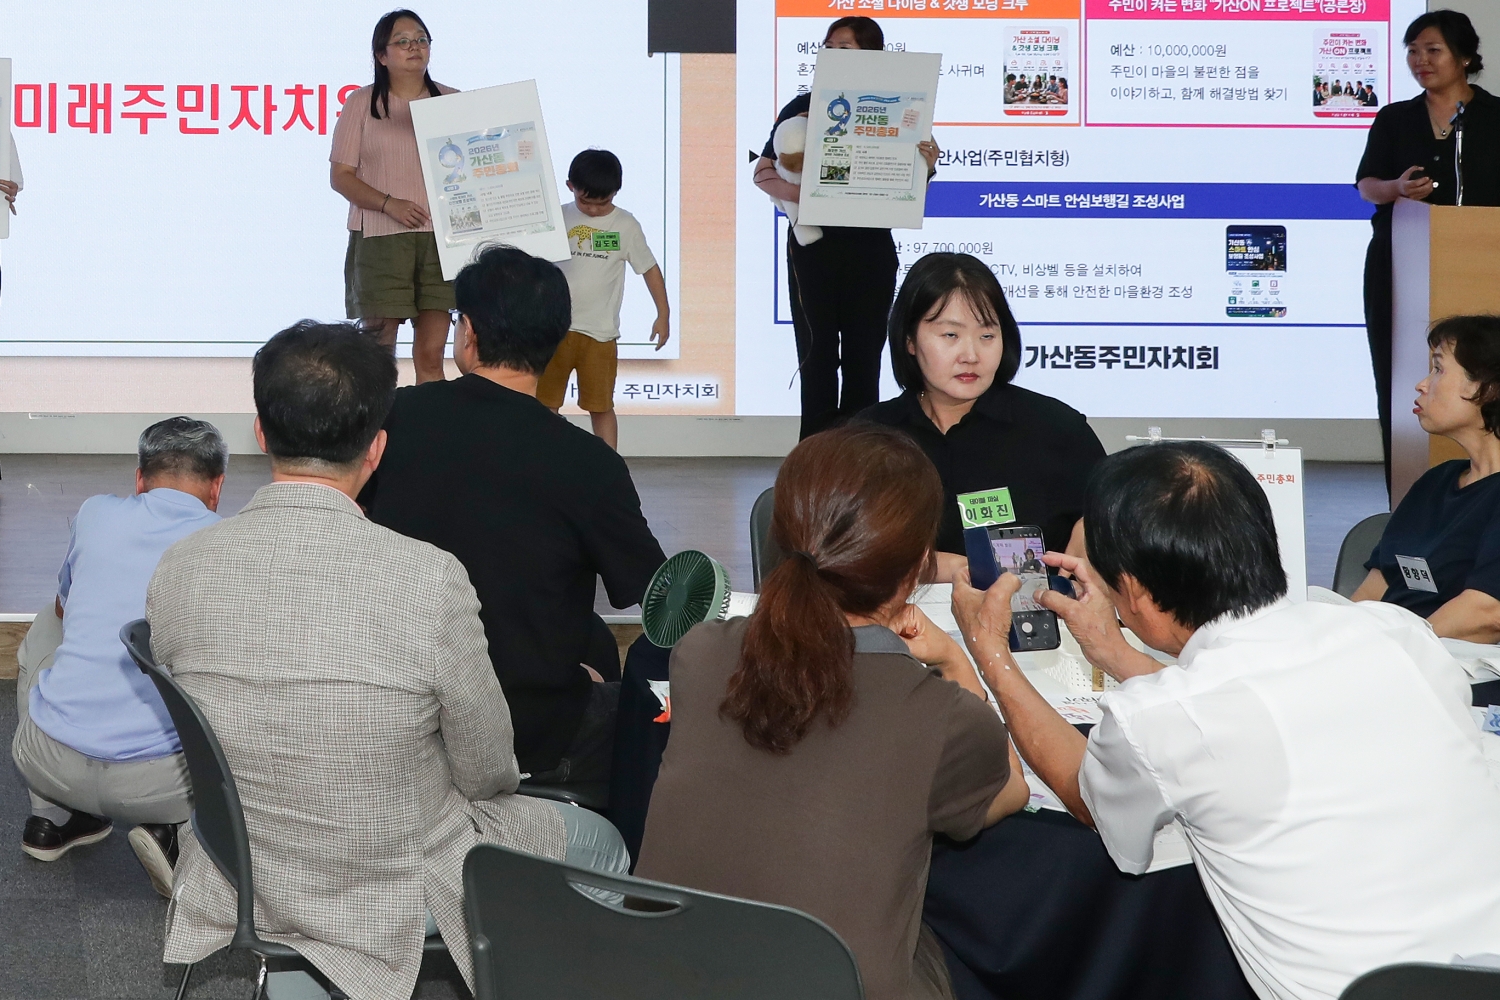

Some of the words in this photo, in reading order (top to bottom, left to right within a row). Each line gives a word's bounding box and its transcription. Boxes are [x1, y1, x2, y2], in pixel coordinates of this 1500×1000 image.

[1110, 44, 1135, 57] 예산
[1148, 44, 1227, 58] 10,000,000원
[1110, 65, 1147, 79] 주민이
[1152, 65, 1189, 79] 마을의
[1193, 65, 1231, 79] 불편한
[1234, 65, 1260, 79] 점을
[1110, 87, 1176, 101] 이야기하고,
[1181, 87, 1205, 101] 함께
[1209, 87, 1259, 101] 해결방법
[1264, 87, 1288, 101] 찾기
[14, 82, 362, 136] 미래주민자치
[855, 114, 889, 126] 가산동
[854, 126, 899, 137] 주민총회
[979, 193, 1019, 209] 가산동
[1022, 193, 1062, 209] 스마트
[1064, 193, 1129, 209] 안심보행길
[1132, 193, 1185, 209] 조성사업
[1022, 263, 1059, 278] 비상벨
[1064, 263, 1088, 278] 등을
[1092, 263, 1142, 278] 설치하여
[1044, 284, 1068, 299] 통해
[1072, 284, 1109, 299] 안전한
[1114, 284, 1164, 299] 마을환경
[1168, 284, 1193, 299] 조성
[1025, 345, 1219, 370] 가산동주민자치회
[623, 383, 719, 400] 주민자치회
[1256, 474, 1295, 484] 주민총회
